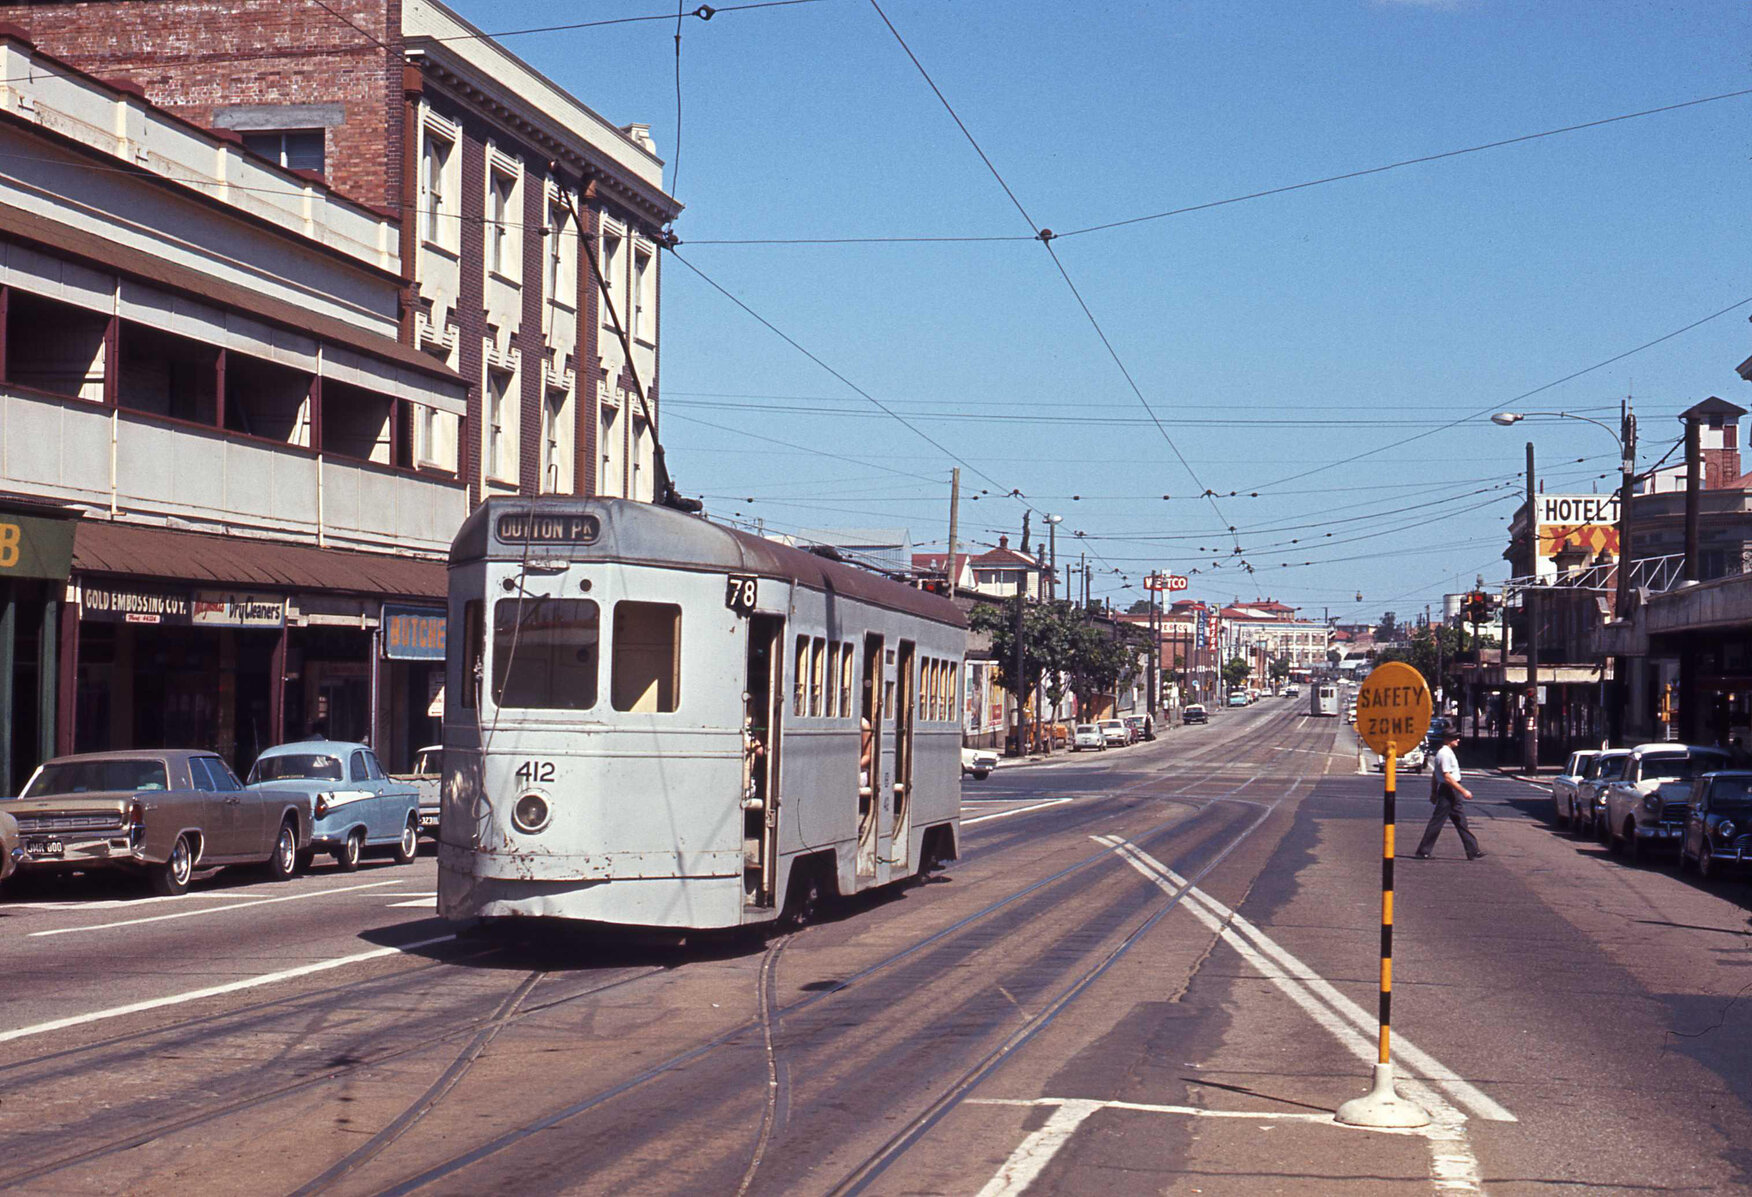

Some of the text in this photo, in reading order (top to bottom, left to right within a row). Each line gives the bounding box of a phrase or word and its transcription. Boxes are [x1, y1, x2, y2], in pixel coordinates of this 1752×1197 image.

[1545, 498, 1607, 521] HOTEL
[85, 588, 110, 611] GOLD
[111, 592, 164, 614] EMBOSSING
[729, 579, 756, 607] 78
[245, 595, 281, 620] Cleaners
[1361, 686, 1425, 708] SAFETY
[1369, 716, 1415, 735] ZONE
[515, 761, 556, 783] 412
